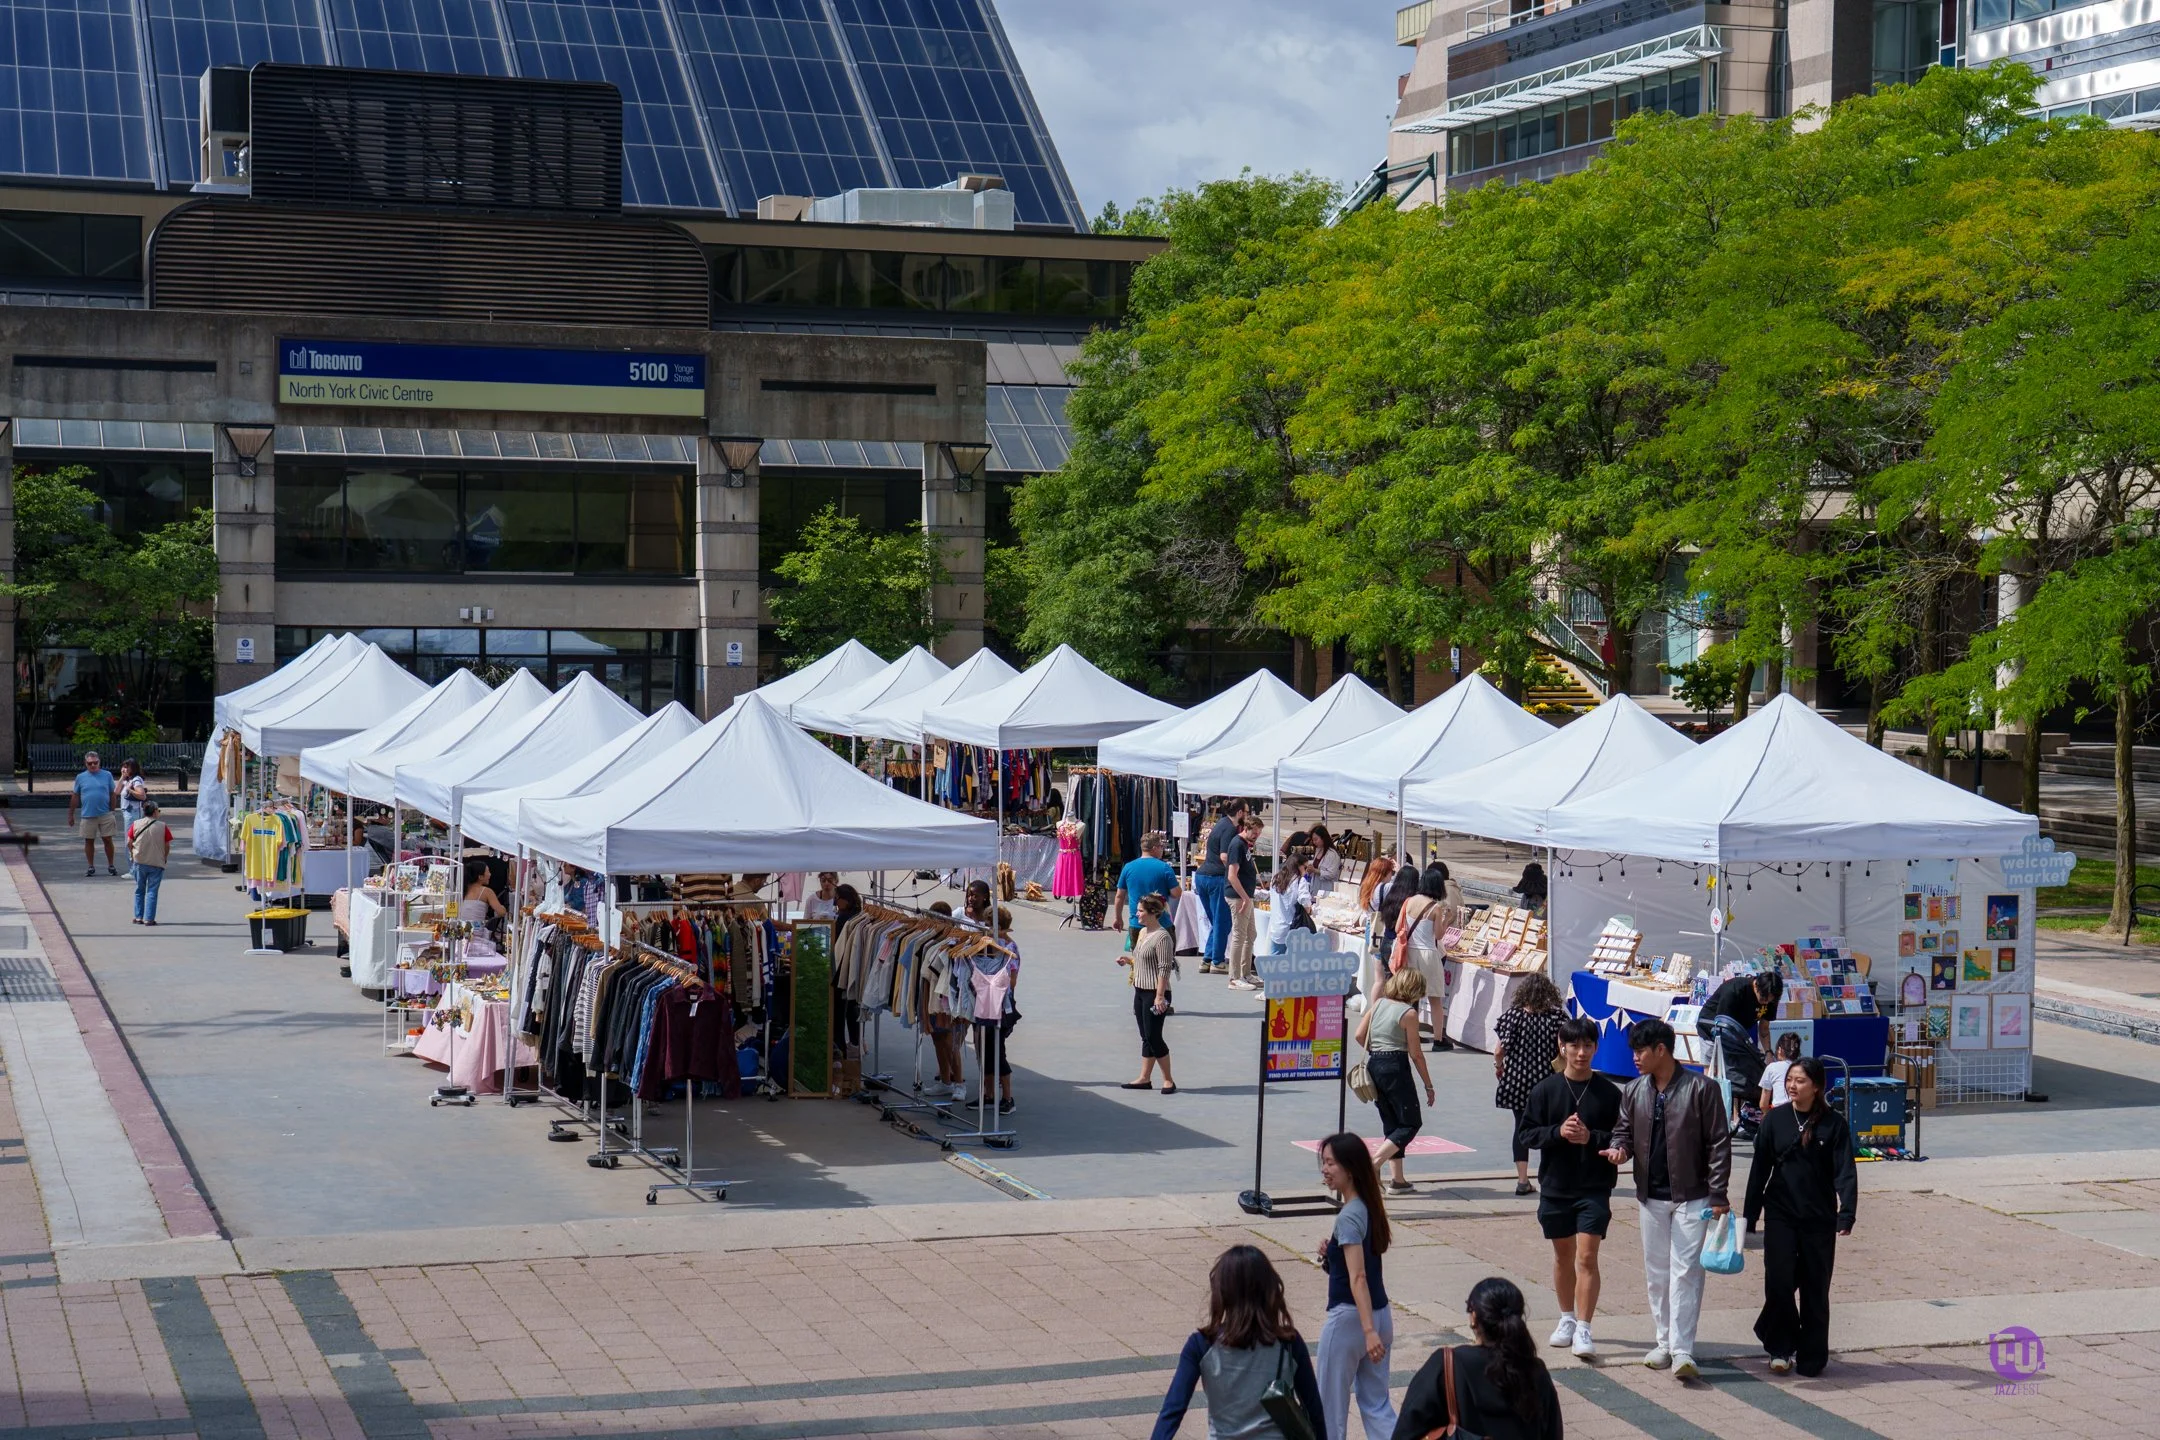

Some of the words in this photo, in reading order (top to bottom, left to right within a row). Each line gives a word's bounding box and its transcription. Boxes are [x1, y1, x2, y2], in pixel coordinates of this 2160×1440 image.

[309, 350, 363, 371] TORONTO
[674, 364, 694, 374] Yonge
[629, 362, 668, 382] 5100
[674, 373, 694, 383] Street
[289, 381, 325, 399] North
[328, 383, 356, 399] York
[359, 383, 389, 400] Civic
[392, 385, 434, 402] Centre
[2025, 838, 2052, 852] the
[2003, 853, 2073, 869] welcome
[2009, 868, 2066, 884] market
[1291, 933, 1326, 952] the
[1260, 953, 1356, 974] welcome
[1268, 972, 1347, 994] market
[1872, 1100, 1888, 1113] 20
